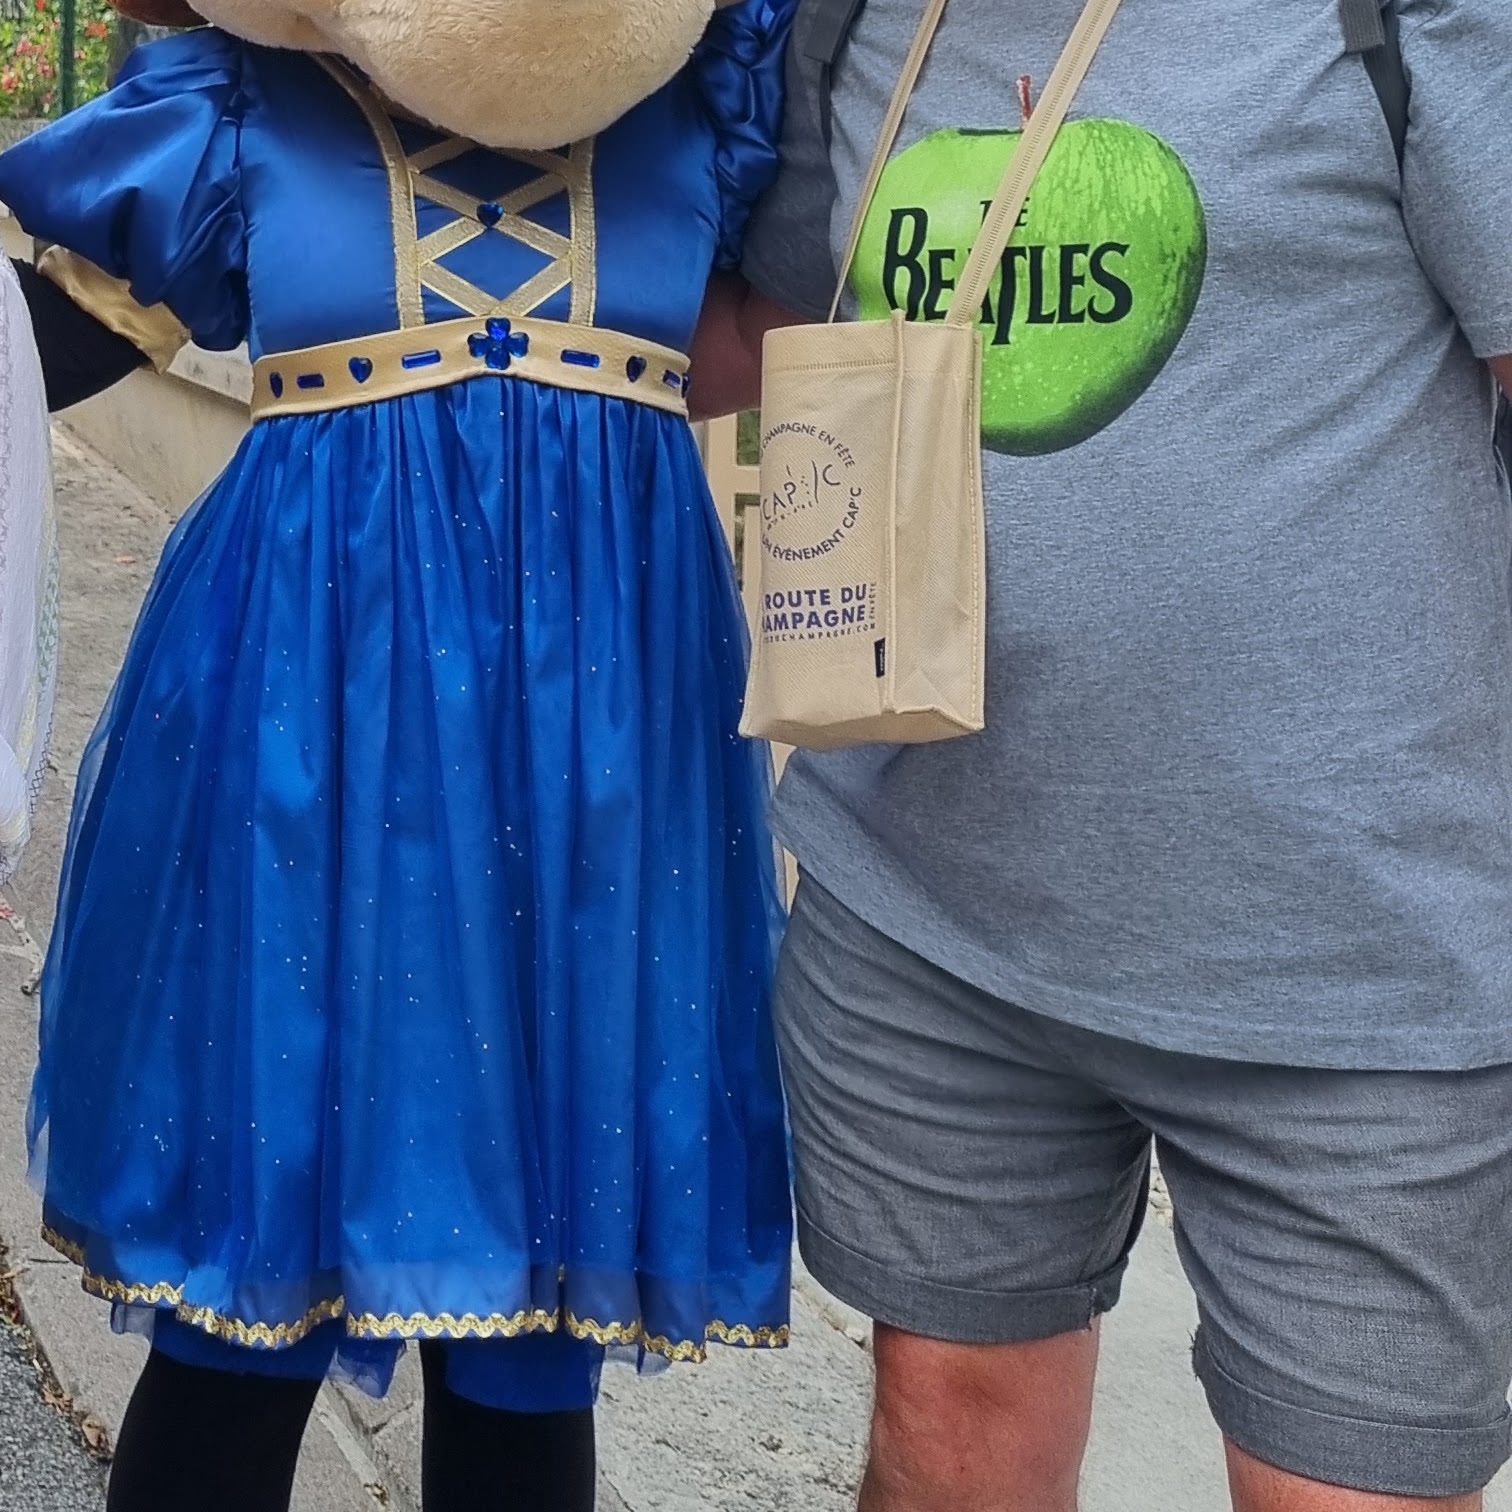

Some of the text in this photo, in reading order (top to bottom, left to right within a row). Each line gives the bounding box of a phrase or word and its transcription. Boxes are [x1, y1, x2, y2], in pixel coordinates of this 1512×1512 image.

[818, 430, 836, 446] EN
[764, 583, 867, 610] ROUTE DU
